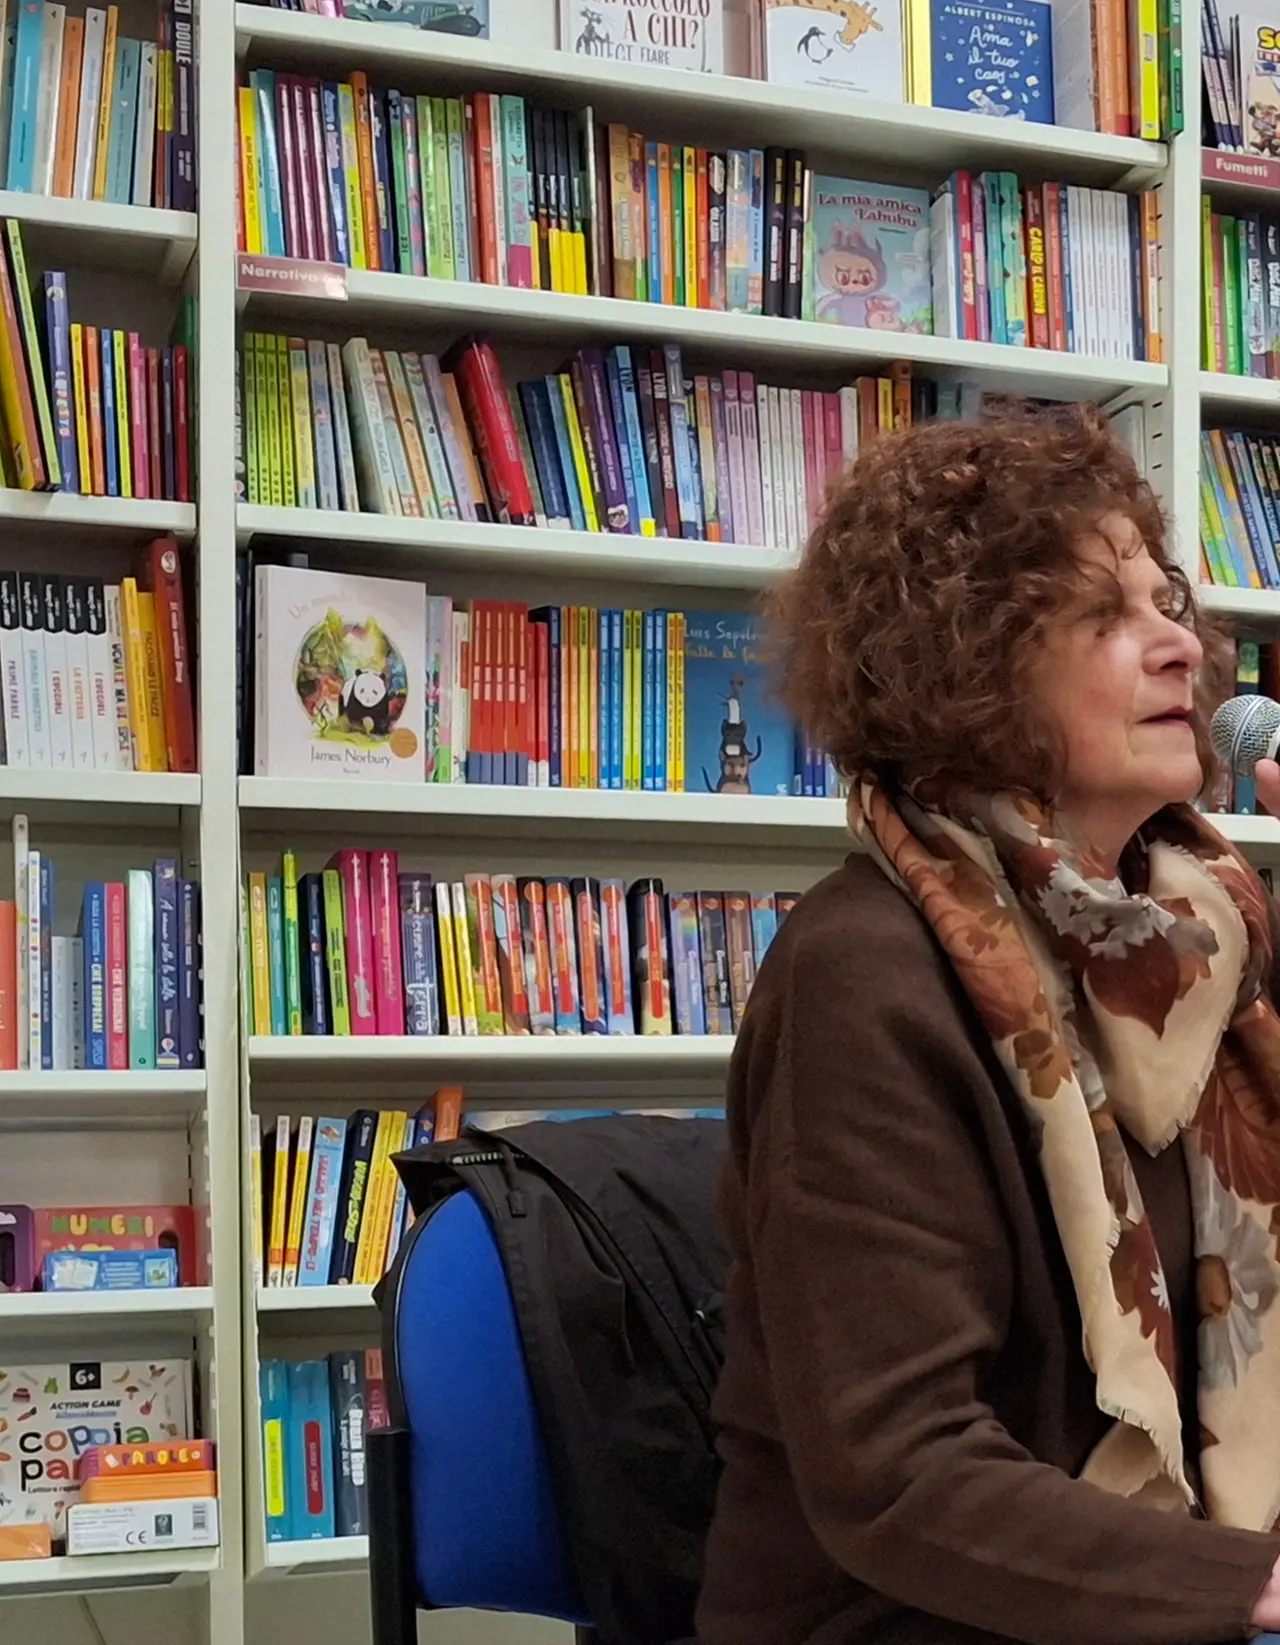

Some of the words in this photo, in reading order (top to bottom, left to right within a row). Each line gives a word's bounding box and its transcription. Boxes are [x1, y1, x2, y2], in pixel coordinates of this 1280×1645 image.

[944, 6, 981, 18] ALBERT
[985, 11, 1036, 27] ESPINOSA
[623, 9, 637, 43] A
[648, 12, 699, 49] CHI?
[969, 26, 1013, 48] Ama
[1215, 157, 1269, 178] Fumetti
[818, 193, 838, 206] La
[839, 195, 872, 208] mia
[875, 198, 922, 216] amica
[854, 208, 918, 229] Labubu
[241, 263, 317, 284] Narrativa
[653, 373, 666, 399] LYON
[9, 661, 18, 686] PRIME
[9, 689, 20, 720] PAROLE
[309, 747, 342, 763] James
[345, 750, 393, 770] Norbury
[52, 1214, 154, 1238] NUMERI
[49, 1401, 90, 1411] ACTION
[92, 1400, 122, 1409] GAME
[19, 1422, 150, 1456] coppia
[122, 1449, 188, 1466] PAROLE
